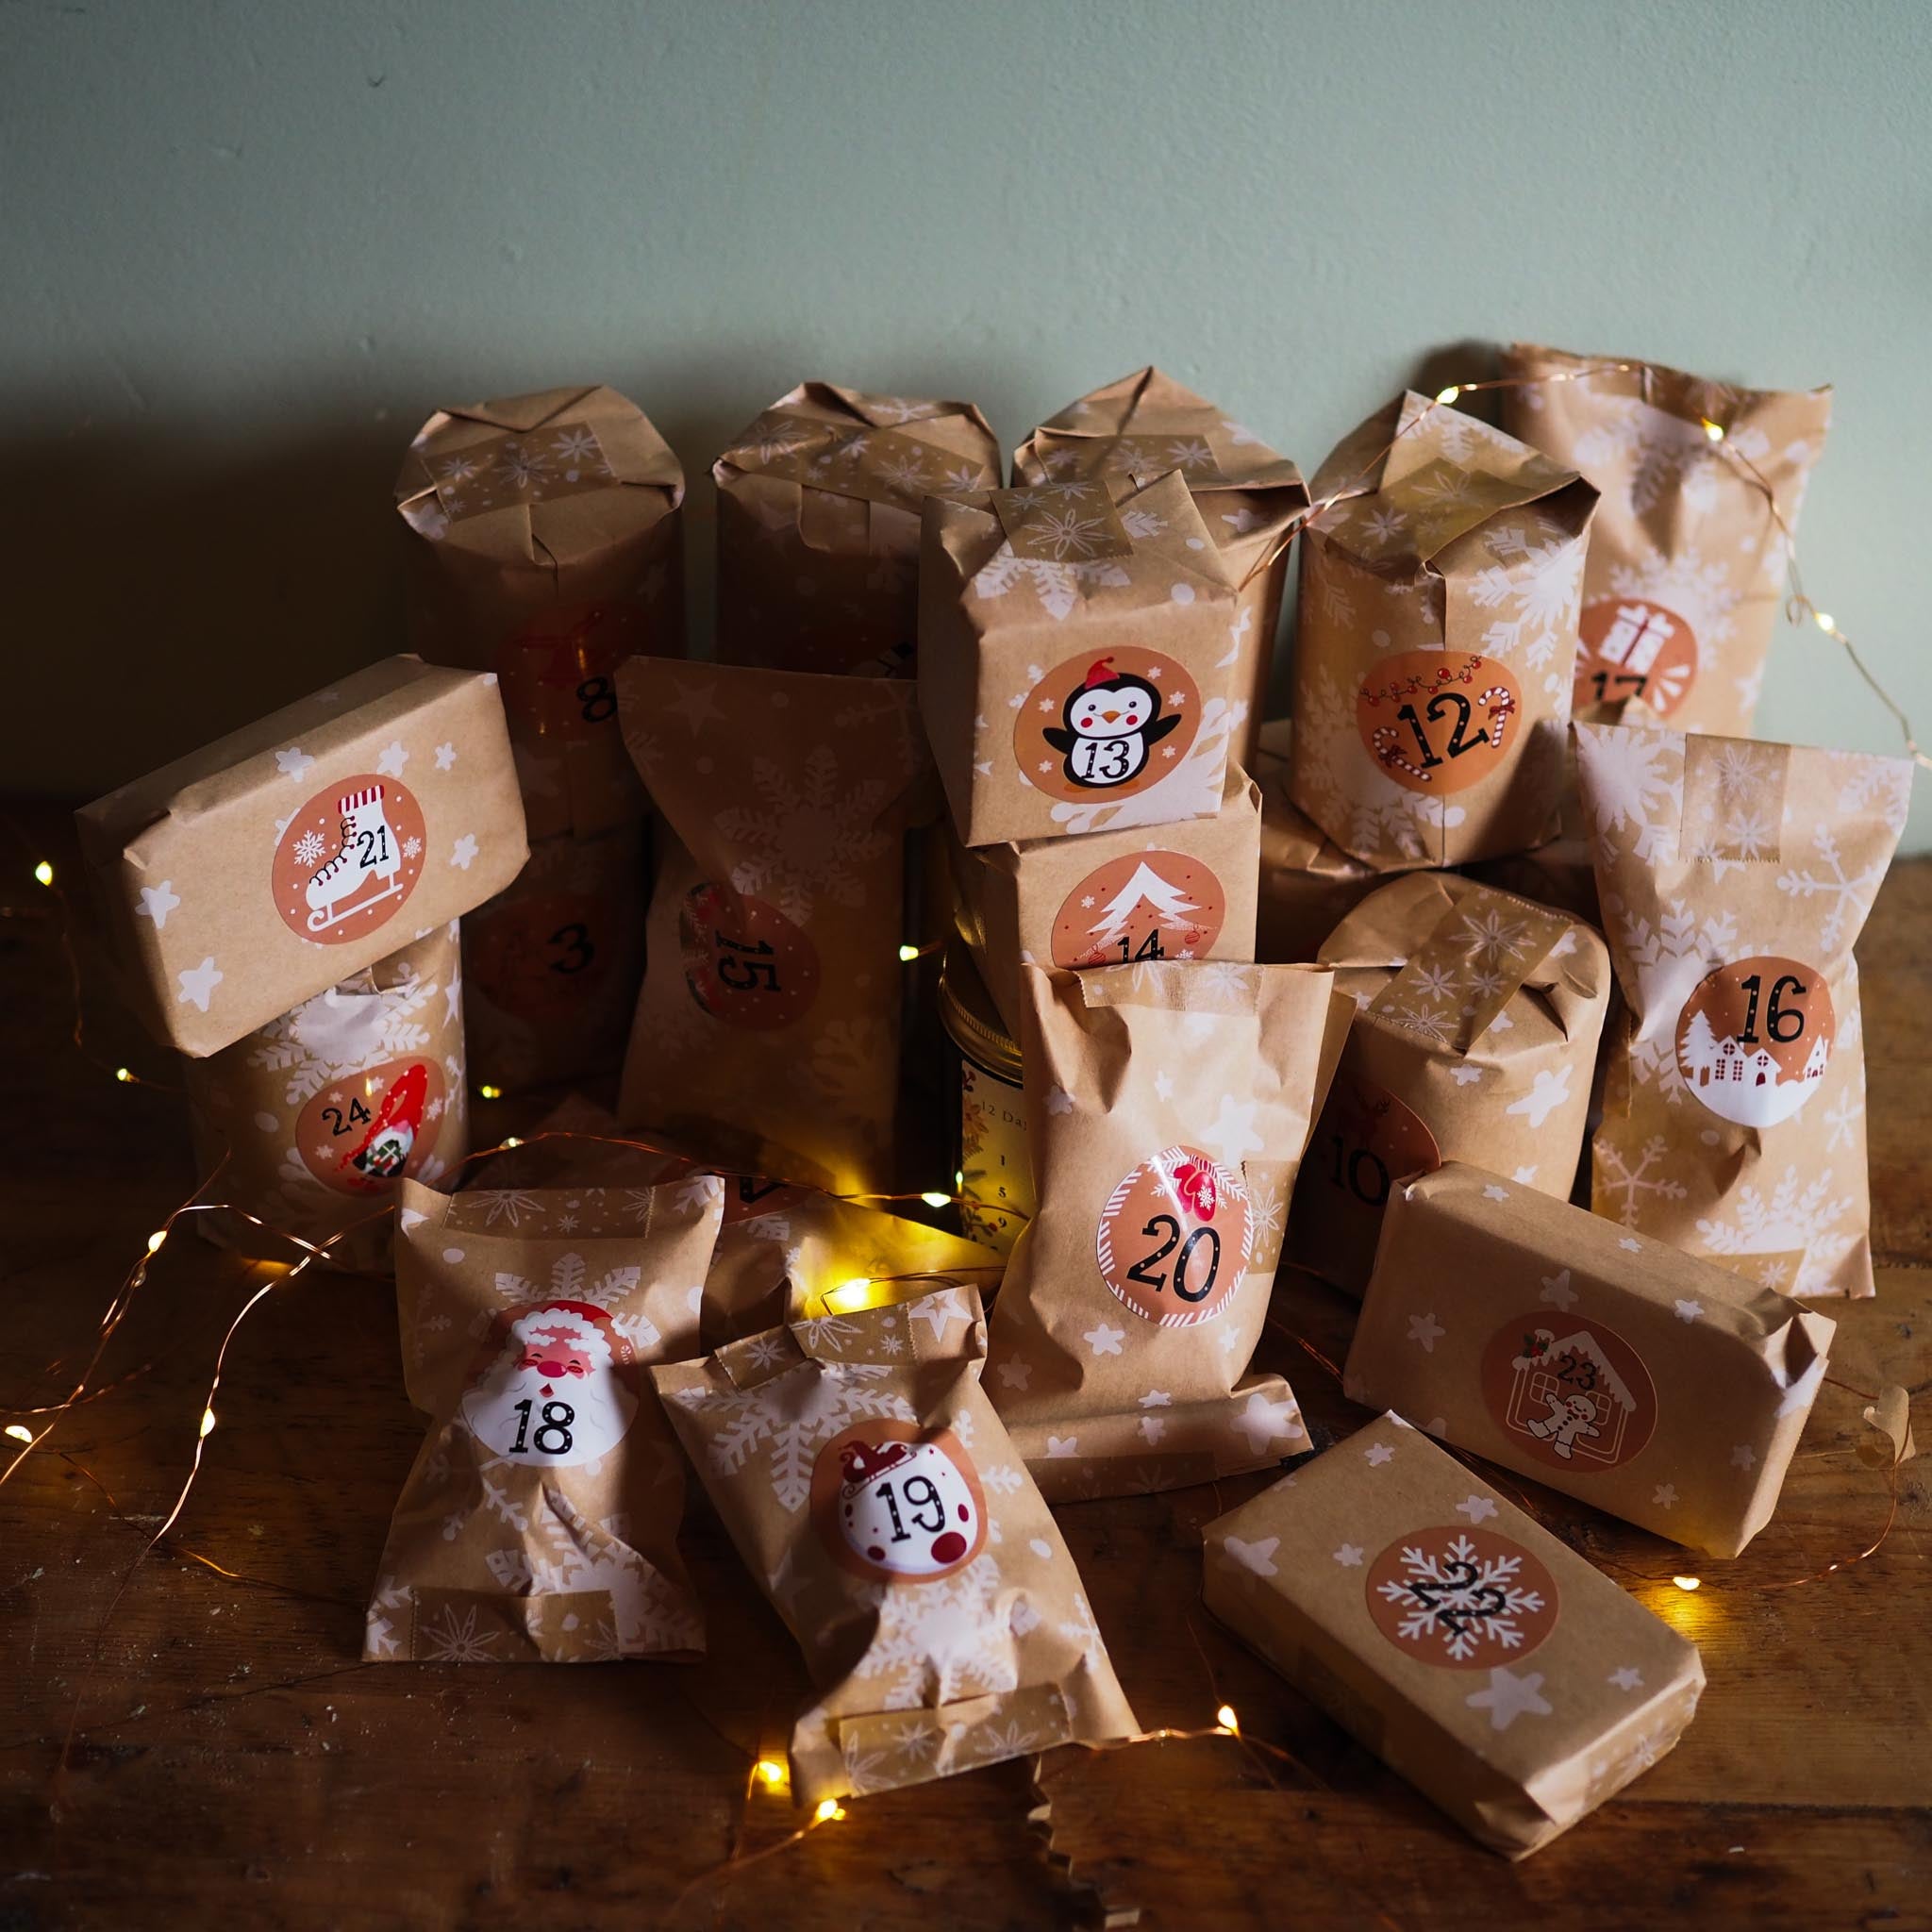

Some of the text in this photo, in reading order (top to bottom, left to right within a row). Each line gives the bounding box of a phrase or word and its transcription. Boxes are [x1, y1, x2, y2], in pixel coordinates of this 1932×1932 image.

[576, 676, 616, 723] 8
[1397, 692, 1490, 769] 12
[1081, 739, 1130, 779] 13
[357, 825, 389, 869] 21
[550, 923, 594, 974] 3
[715, 929, 782, 992] 15
[1117, 929, 1165, 964] 14
[1737, 974, 1807, 1043] 16
[322, 1097, 372, 1137] 24
[981, 1101, 996, 1116] 12
[1330, 1135, 1390, 1207] 10
[1126, 1214, 1221, 1303] 20
[1557, 1355, 1597, 1390] 23
[508, 1399, 575, 1455] 18
[875, 1475, 946, 1543] 19
[1408, 1561, 1507, 1637] 22
